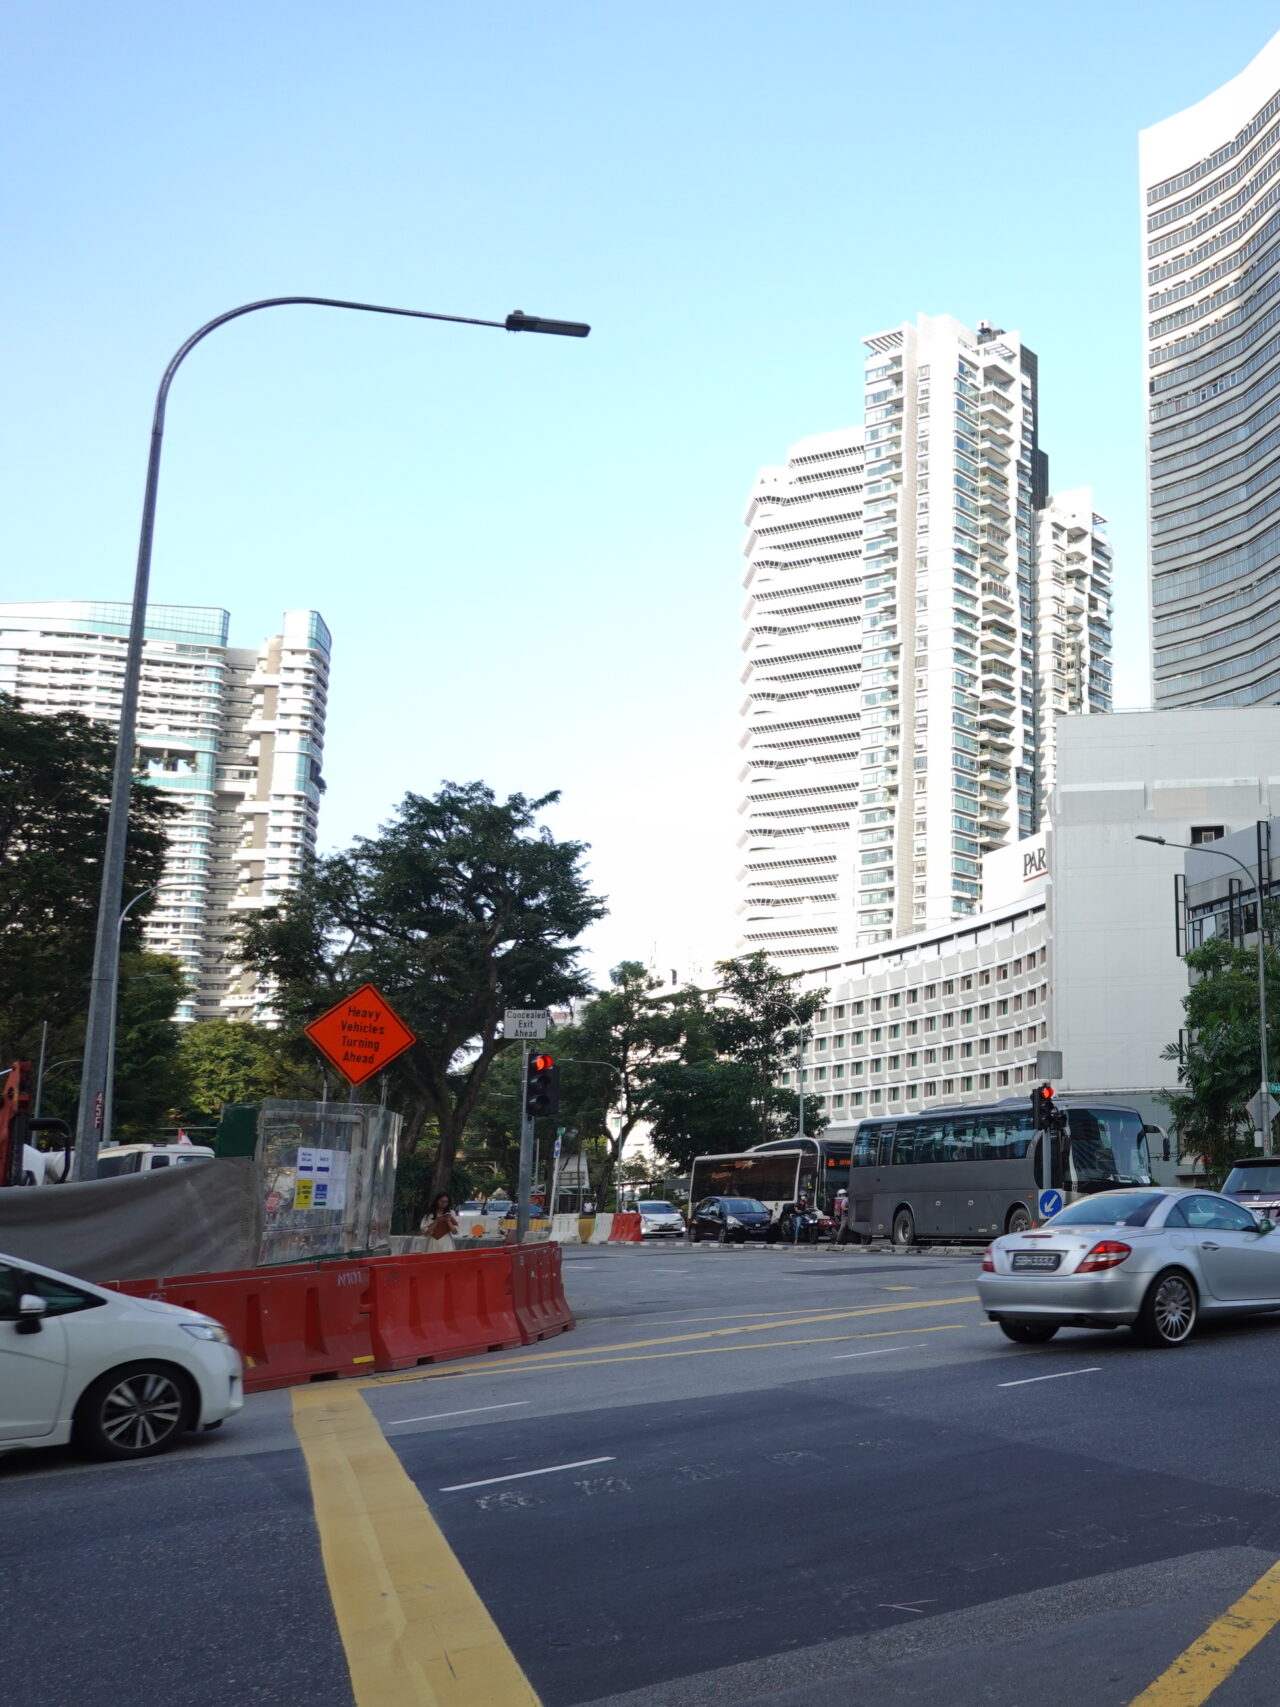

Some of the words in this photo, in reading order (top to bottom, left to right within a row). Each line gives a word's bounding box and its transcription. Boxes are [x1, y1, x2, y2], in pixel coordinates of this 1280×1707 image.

[1023, 847, 1047, 876] PAR
[348, 1006, 381, 1021] Heavy
[507, 1011, 546, 1019] Concealed
[341, 1021, 385, 1034] Vehicles
[519, 1020, 533, 1028] Exit
[514, 1029, 537, 1037] Ahead
[342, 1036, 380, 1052] Turning
[343, 1051, 375, 1064] Ahead
